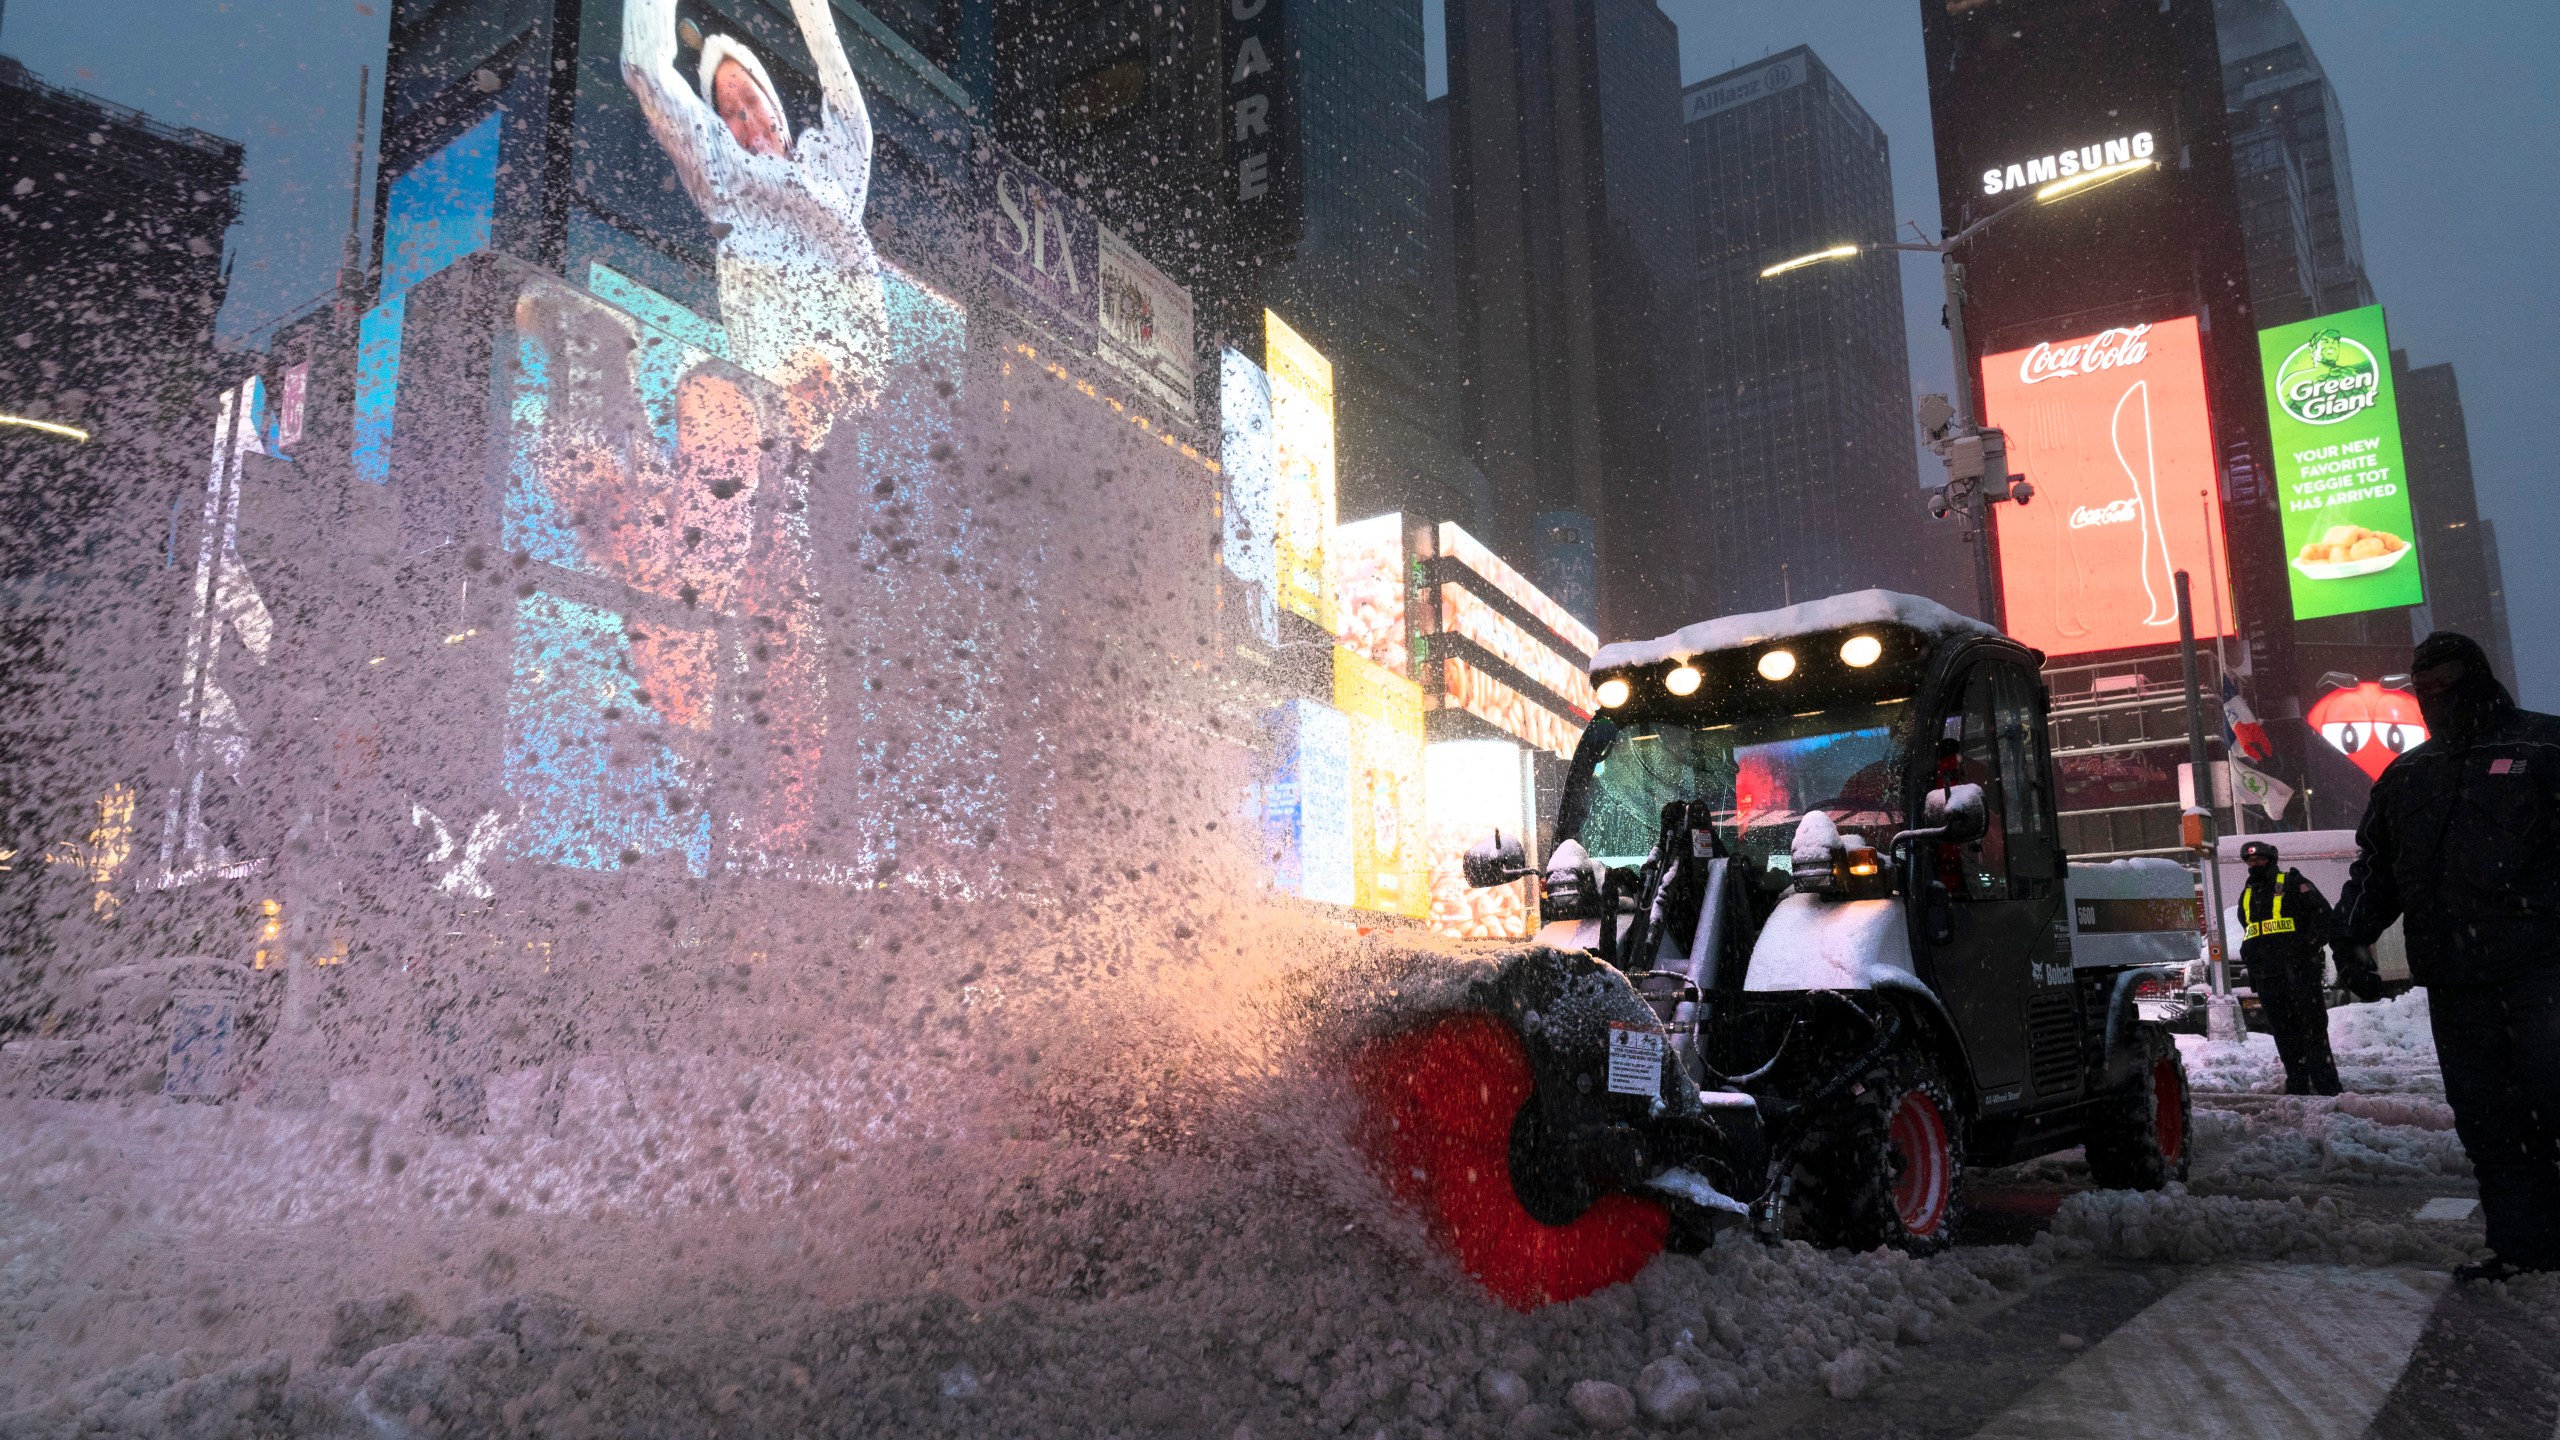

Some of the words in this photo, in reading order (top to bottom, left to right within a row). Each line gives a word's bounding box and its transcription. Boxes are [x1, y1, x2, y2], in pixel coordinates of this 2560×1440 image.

[1693, 79, 1761, 115] Allianz
[1983, 132, 2154, 195] SAMSUNG
[996, 171, 1081, 295] SIX
[2020, 323, 2153, 384] Coca-Cola
[2289, 371, 2374, 402] Green
[2302, 389, 2379, 419] Giant
[2293, 445, 2339, 464] YOUR
[2341, 437, 2380, 454] NEW
[2292, 475, 2354, 495] VEGGIE
[2356, 467, 2390, 485] TOT
[2300, 454, 2378, 479] FAVORITE
[2069, 497, 2140, 529] Coca-Cola
[2289, 496, 2323, 513] HAS
[2325, 484, 2397, 506] ARRIVED
[2077, 906, 2096, 925] 5600
[2263, 919, 2291, 932] SQUARE
[2045, 961, 2075, 986] Bobcat
